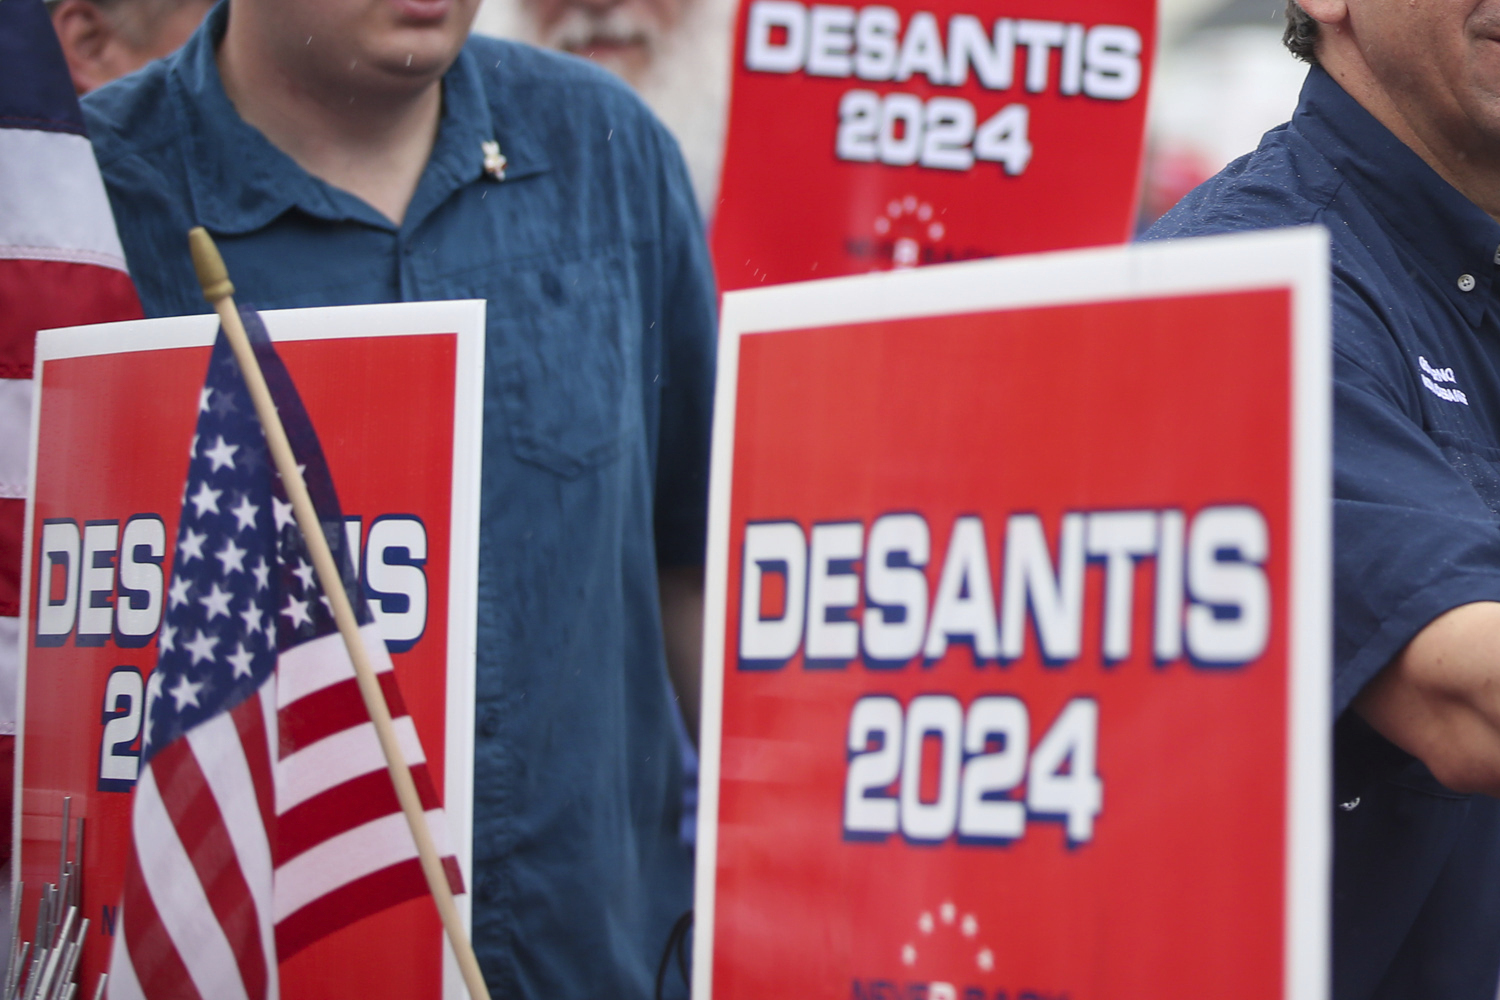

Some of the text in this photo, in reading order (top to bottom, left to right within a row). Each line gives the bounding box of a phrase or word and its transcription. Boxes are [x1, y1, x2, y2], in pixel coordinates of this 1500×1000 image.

[835, 89, 1033, 177] 2024
[736, 503, 1273, 671] DESANTIS
[841, 694, 1104, 851] 2024
